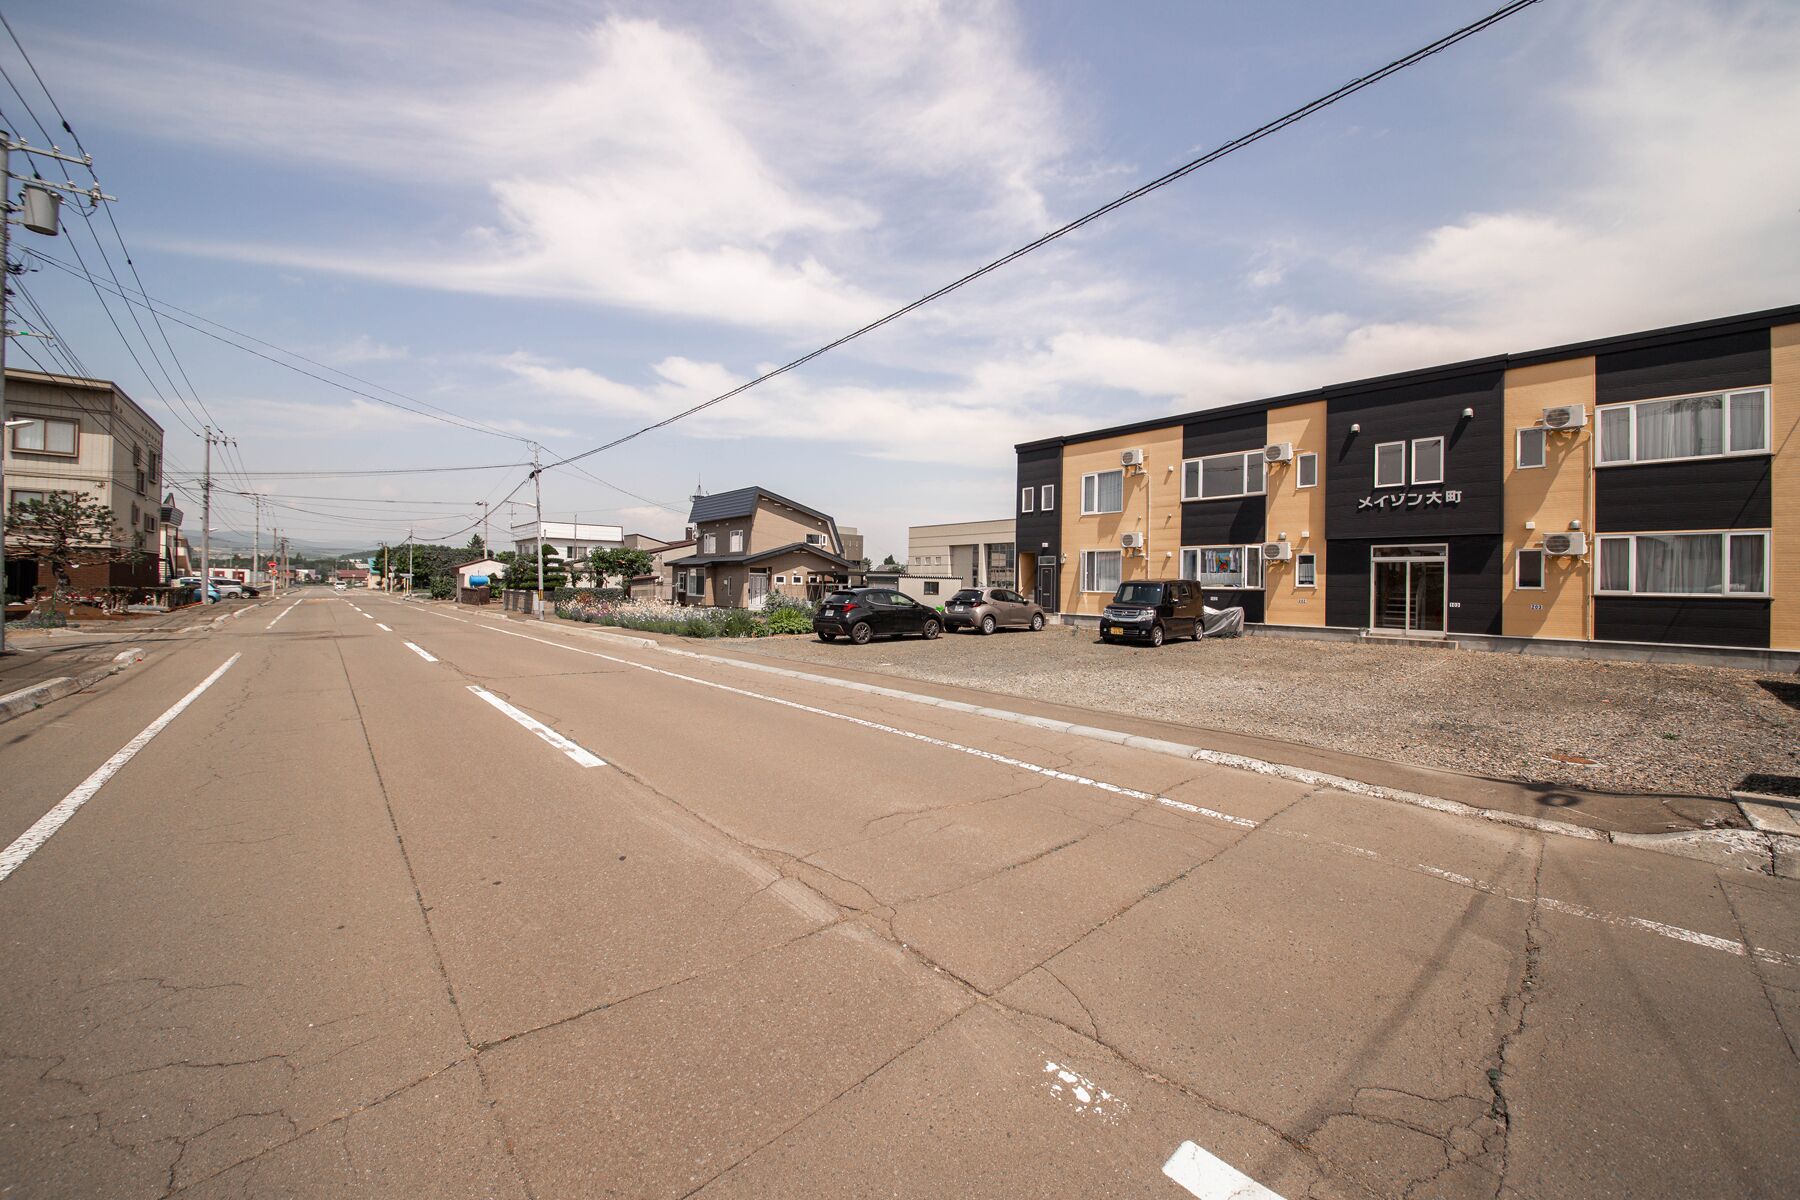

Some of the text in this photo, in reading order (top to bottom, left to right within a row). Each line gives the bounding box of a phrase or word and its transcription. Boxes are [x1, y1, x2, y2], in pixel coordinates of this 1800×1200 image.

[1358, 490, 1462, 509] メイゾン大町
